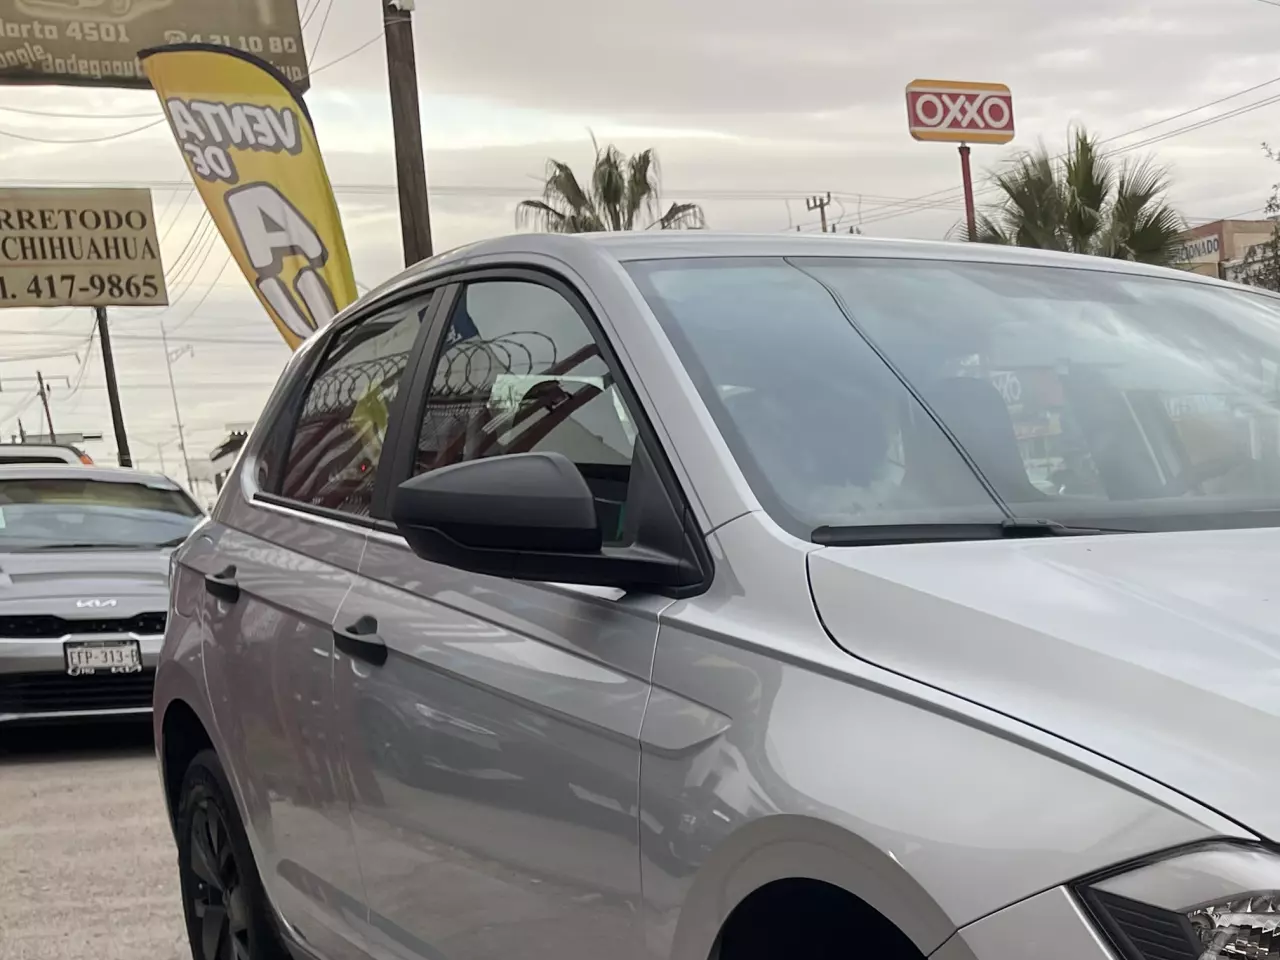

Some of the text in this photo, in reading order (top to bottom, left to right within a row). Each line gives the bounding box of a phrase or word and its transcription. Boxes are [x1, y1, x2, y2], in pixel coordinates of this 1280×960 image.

[66, 21, 129, 43] 4501
[915, 93, 1010, 129] OXXO
[1, 236, 157, 261] CHIHUAHUA
[27, 274, 158, 299] 417-9865
